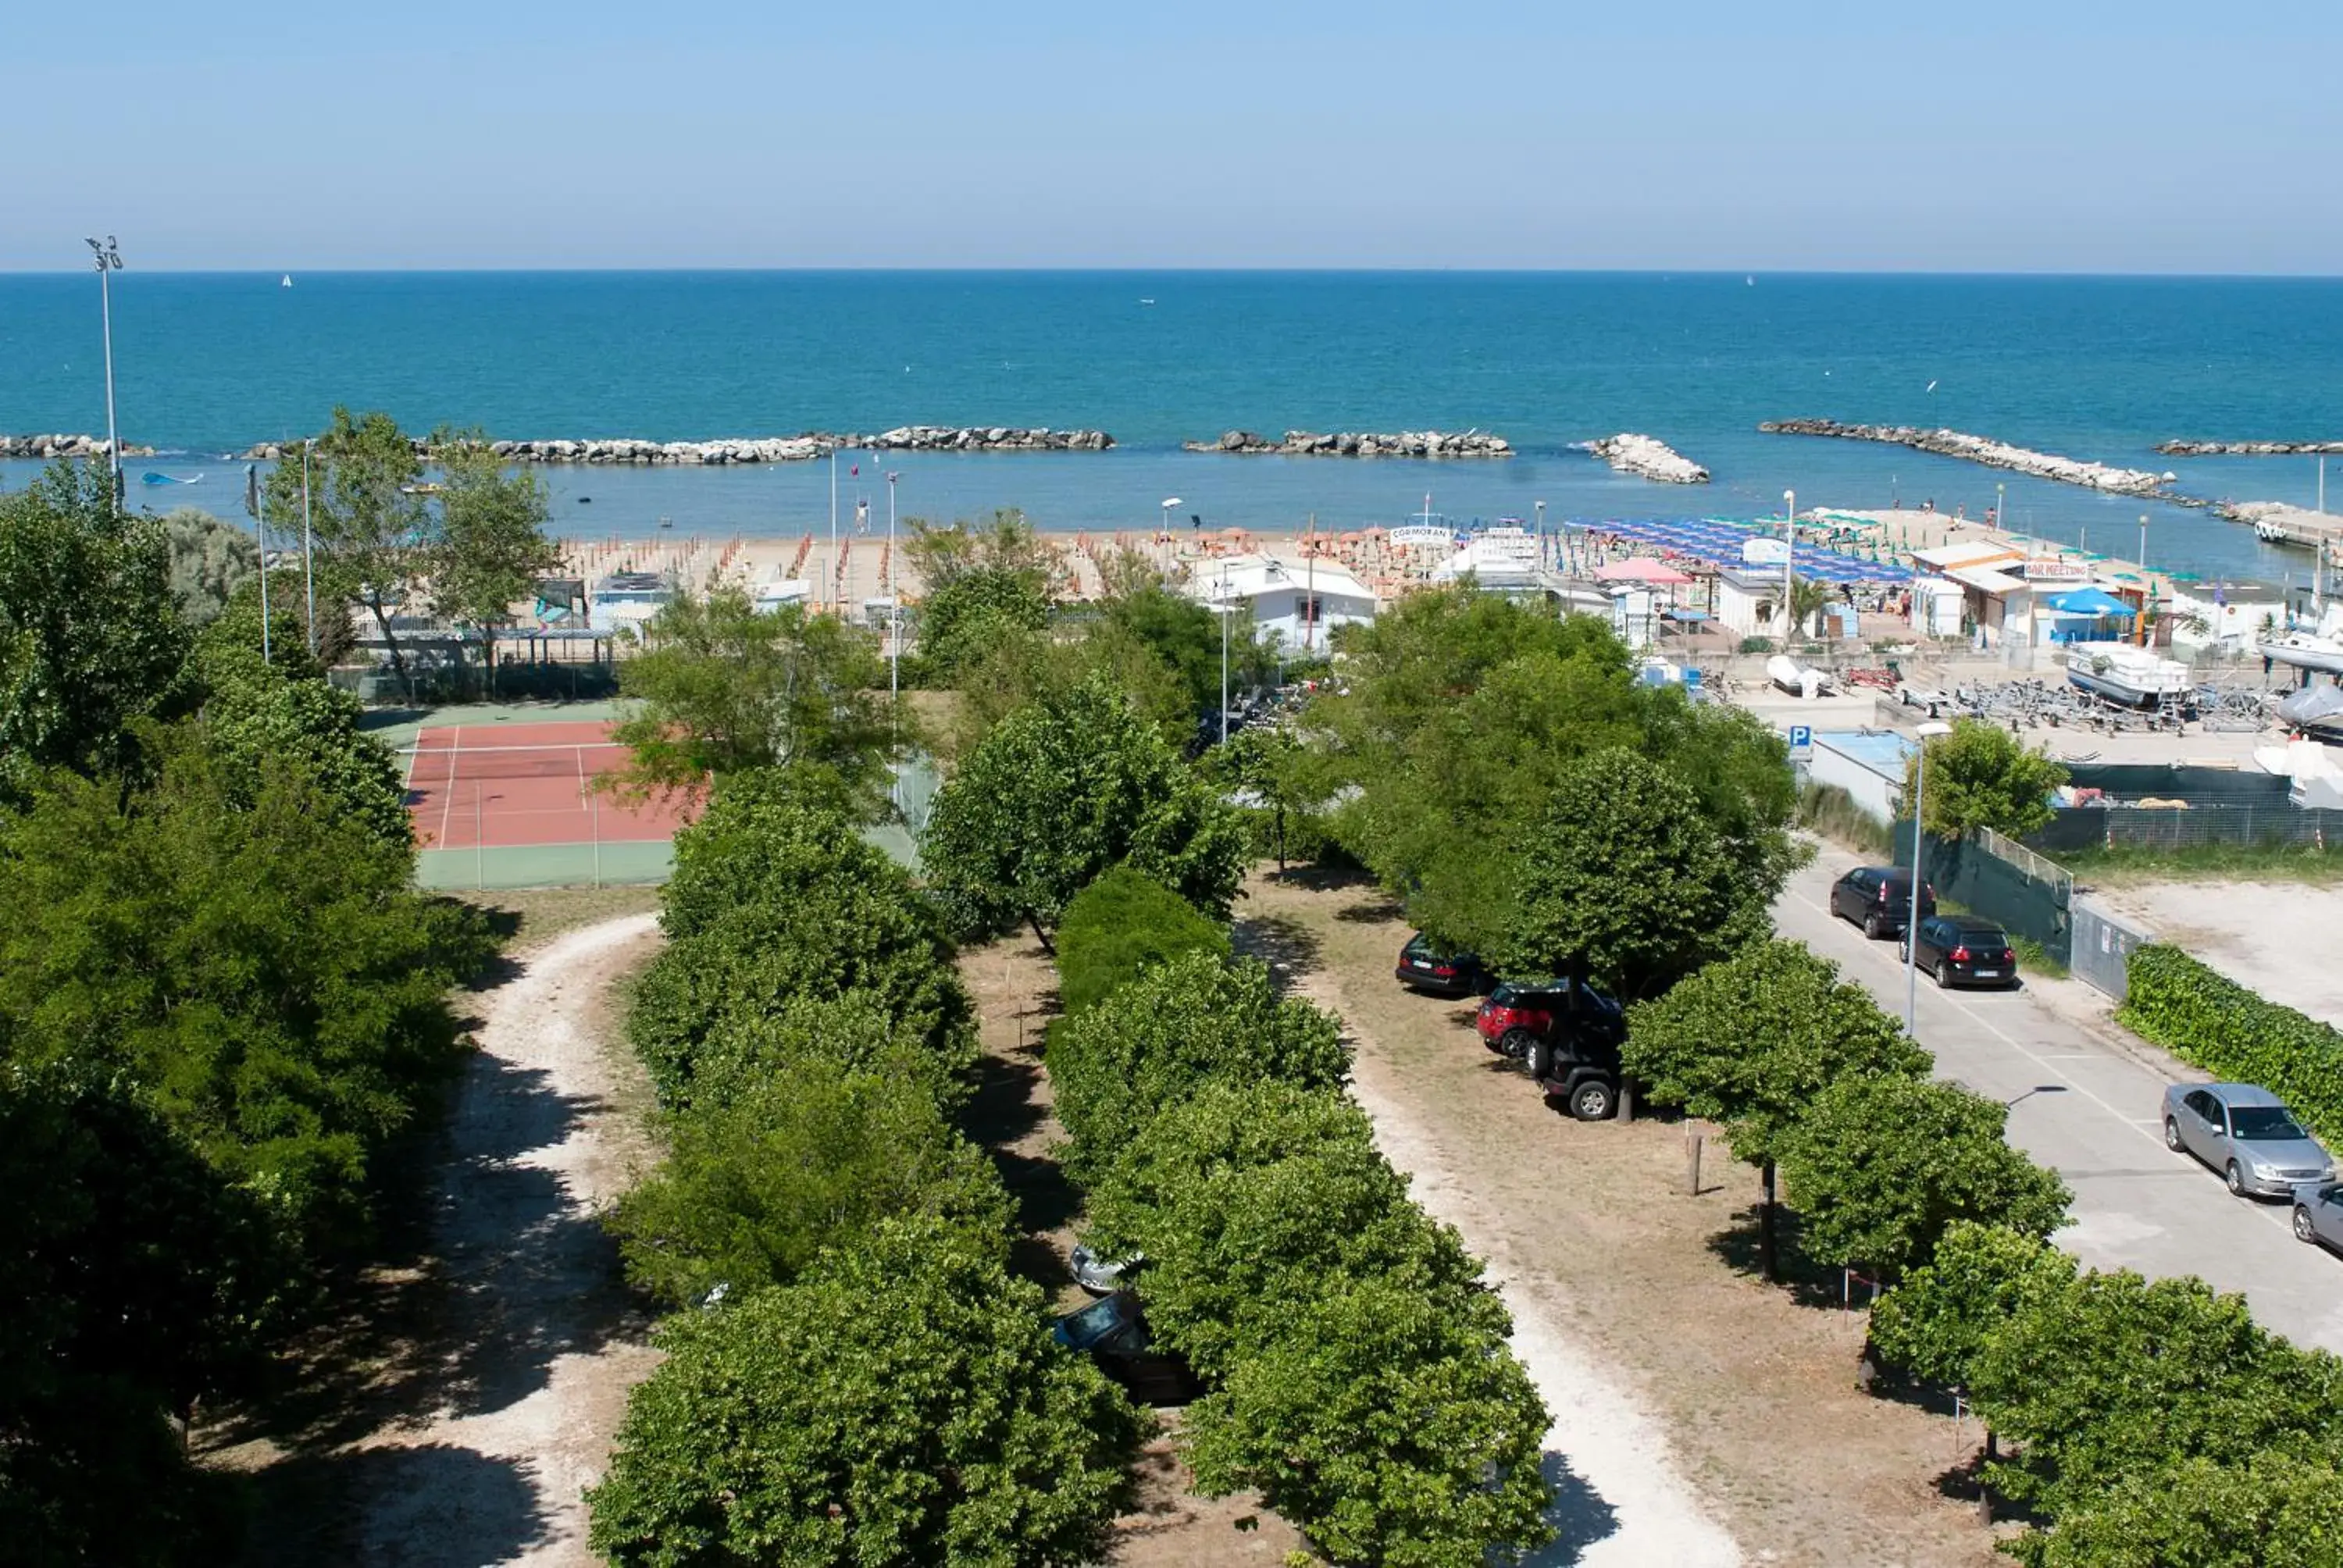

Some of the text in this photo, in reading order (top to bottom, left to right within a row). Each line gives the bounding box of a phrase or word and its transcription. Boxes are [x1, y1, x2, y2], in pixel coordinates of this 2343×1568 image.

[1393, 529, 1447, 538] CORMORAN
[2045, 565, 2086, 576] MEETING
[1792, 727, 1807, 744] P
